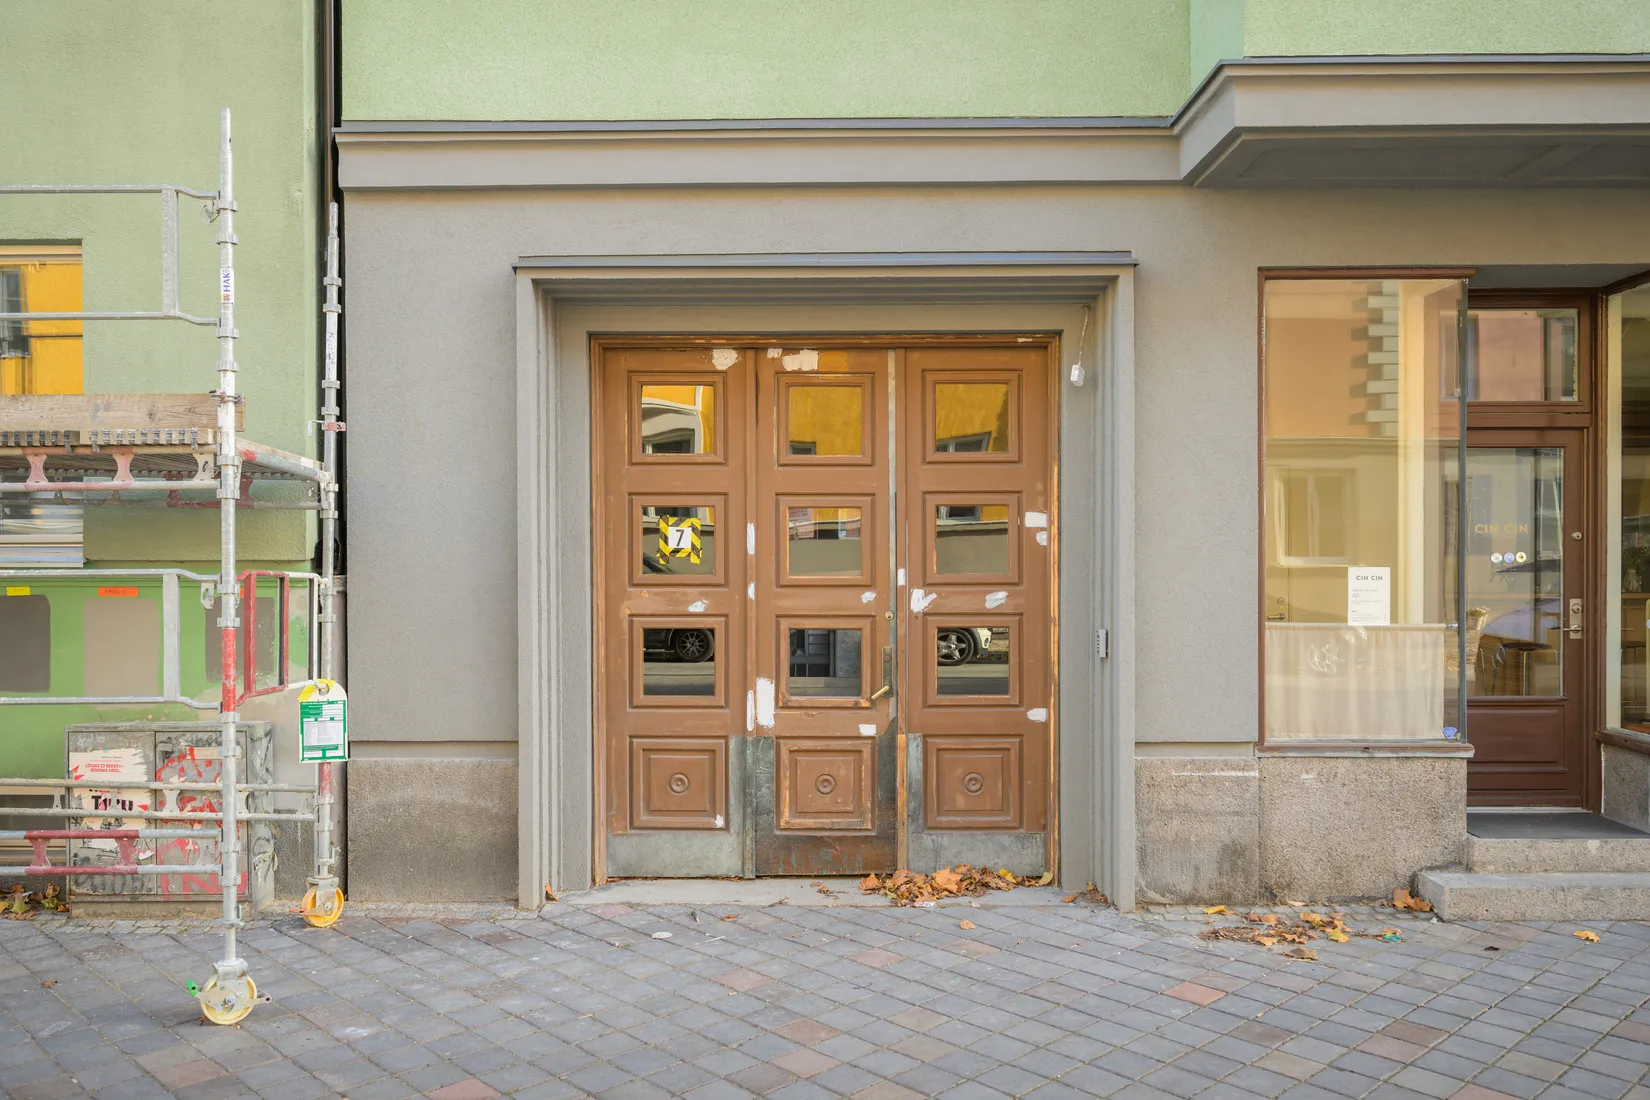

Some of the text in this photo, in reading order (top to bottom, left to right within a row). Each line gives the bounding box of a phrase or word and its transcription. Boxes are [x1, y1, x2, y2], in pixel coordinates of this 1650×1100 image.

[1475, 523, 1529, 534] CIN CIN
[676, 529, 685, 547] 7
